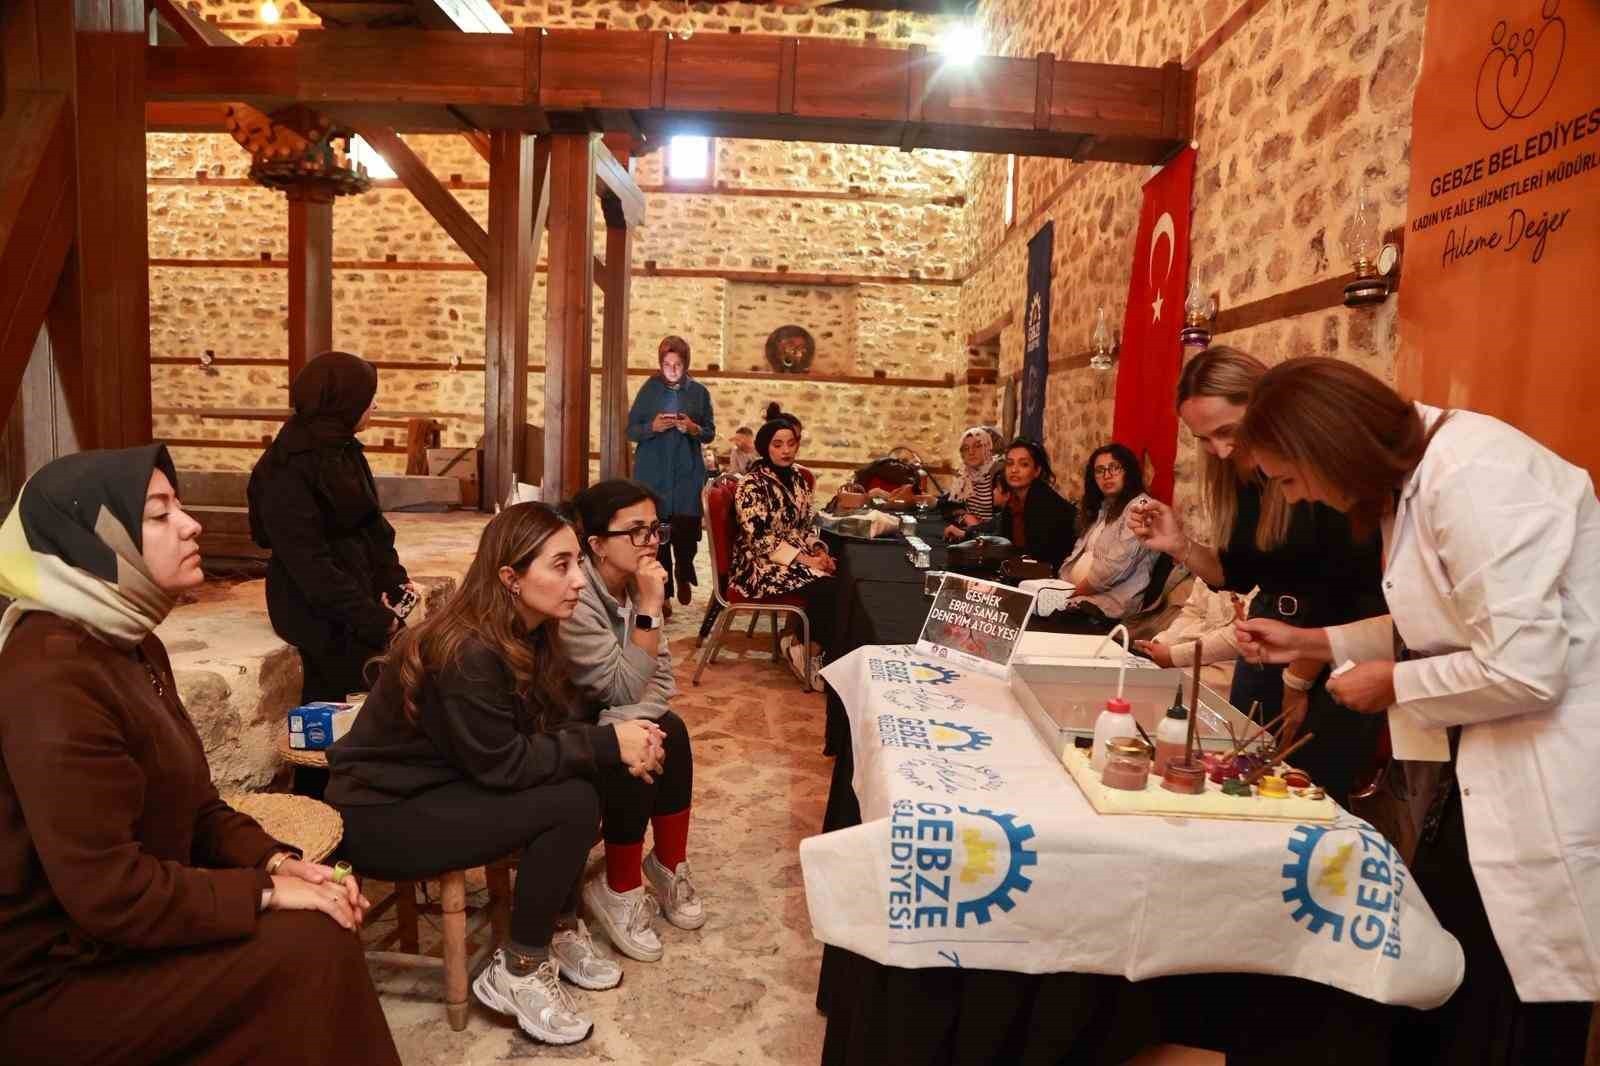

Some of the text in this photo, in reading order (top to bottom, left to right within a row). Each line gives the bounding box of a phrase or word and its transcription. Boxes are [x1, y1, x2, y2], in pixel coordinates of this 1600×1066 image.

[1411, 150, 1600, 232] KADIN VE AİLE HİZMETLERİ MÜDÜRL
[1430, 158, 1485, 198] GEBZE
[949, 598, 1009, 624] EBRU SANATI
[965, 589, 1003, 608] GESMEK
[897, 716, 931, 751] GEBZE
[914, 801, 954, 929] GEBZE
